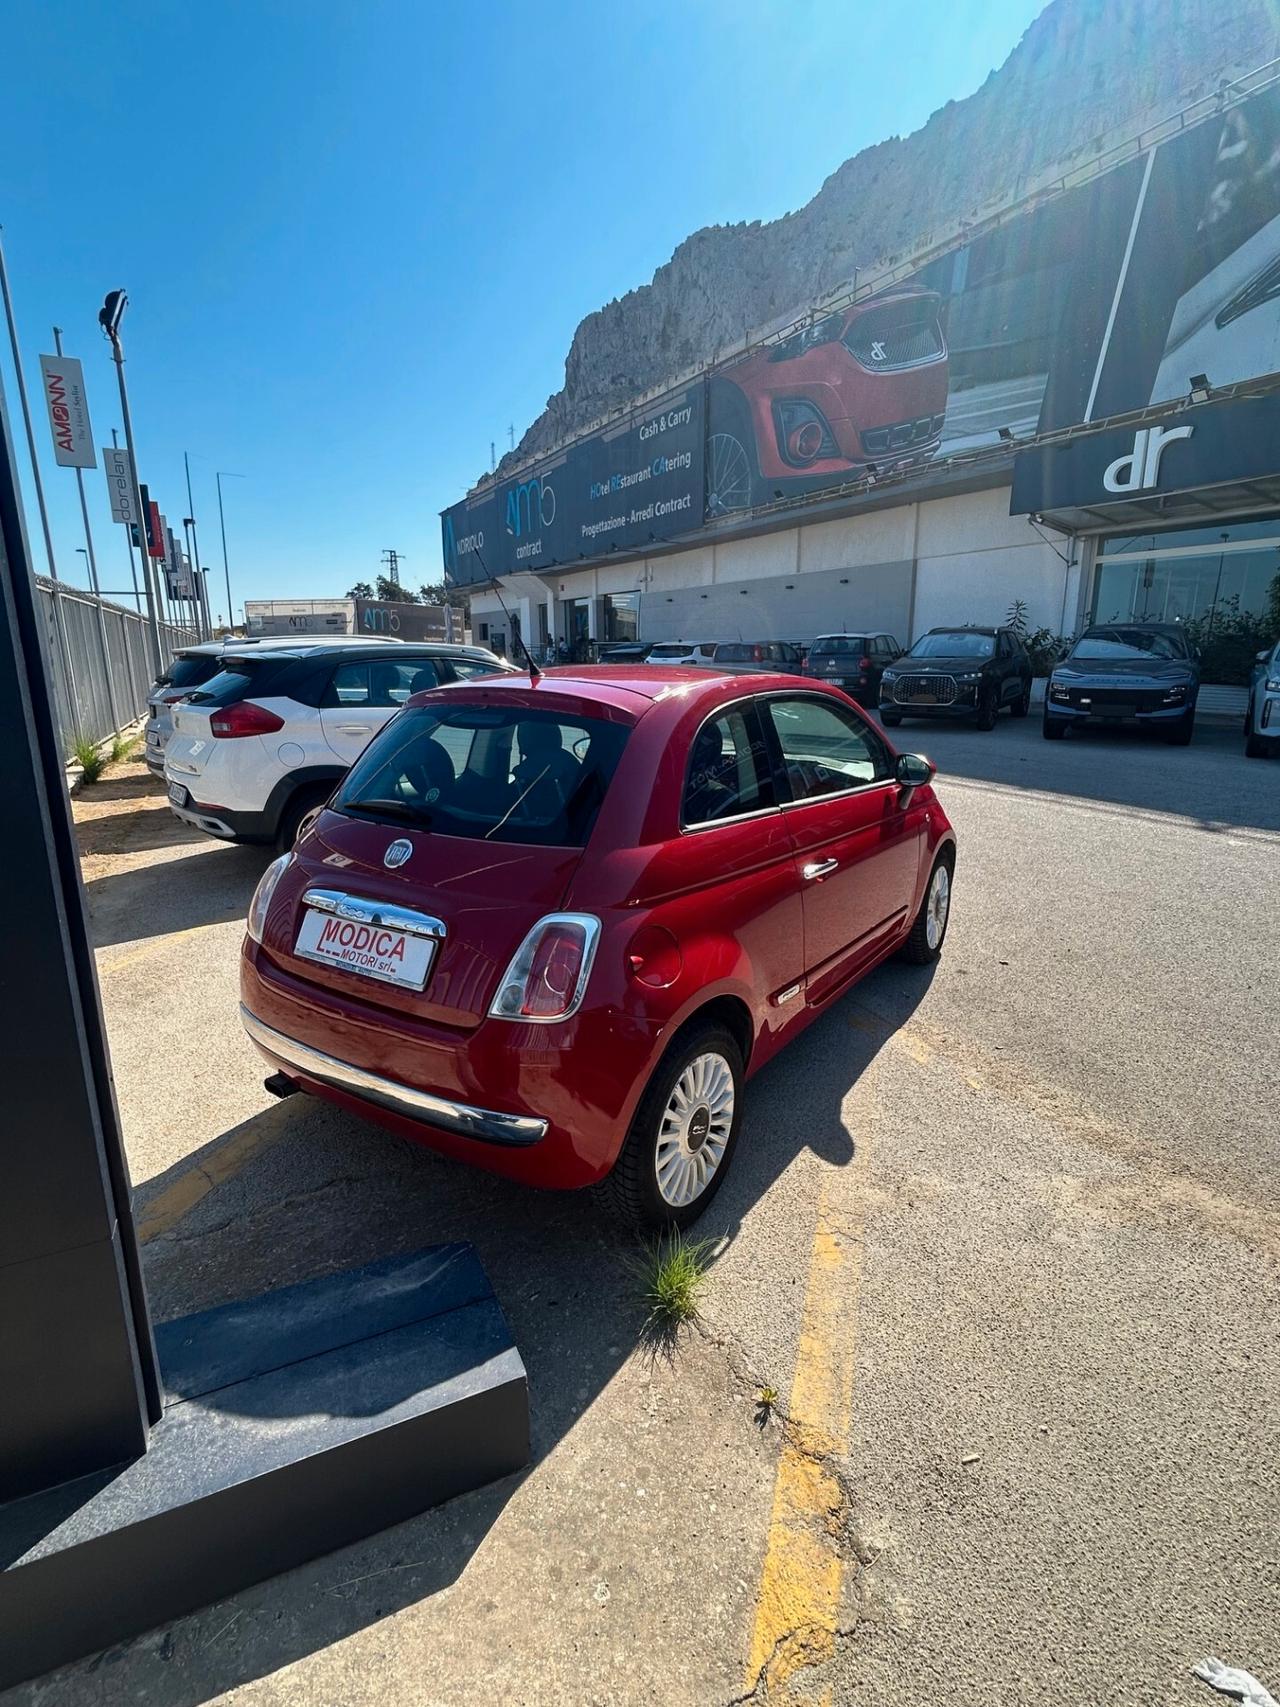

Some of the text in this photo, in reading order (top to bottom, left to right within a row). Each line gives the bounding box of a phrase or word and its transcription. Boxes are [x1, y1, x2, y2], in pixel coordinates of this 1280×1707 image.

[639, 407, 692, 441] Cash & Carry
[590, 452, 692, 500] HOtel REstaurant CAtering
[1103, 426, 1194, 493] dr
[109, 453, 131, 520] dorelan
[581, 515, 626, 538] Progettazione
[630, 503, 654, 524] Arredi
[654, 494, 692, 516] Contract
[516, 538, 542, 560] contract
[317, 918, 406, 962] MODICA
[341, 949, 379, 968] MOTORI
[378, 961, 393, 972] srl
